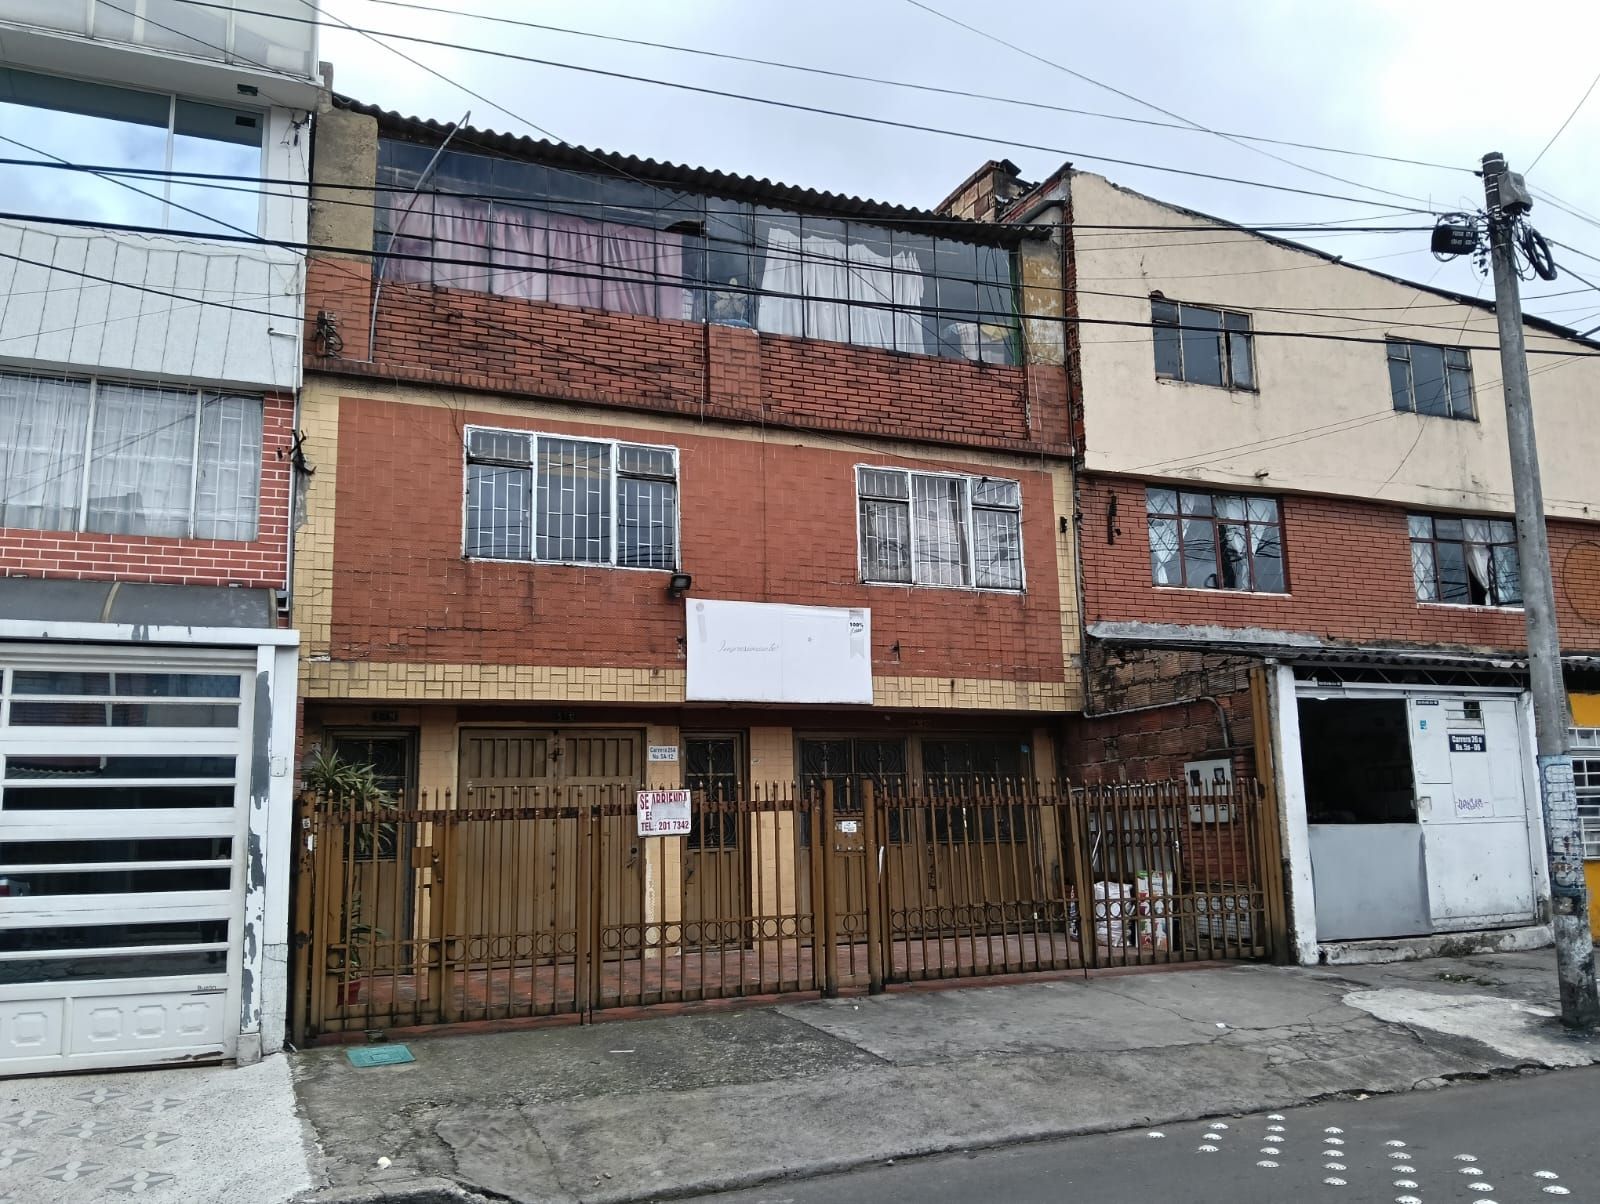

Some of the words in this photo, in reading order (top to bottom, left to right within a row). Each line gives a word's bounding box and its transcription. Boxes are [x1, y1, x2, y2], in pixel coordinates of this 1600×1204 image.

[640, 794, 649, 810] SE
[658, 821, 671, 831] 201
[673, 821, 689, 830] 7342
